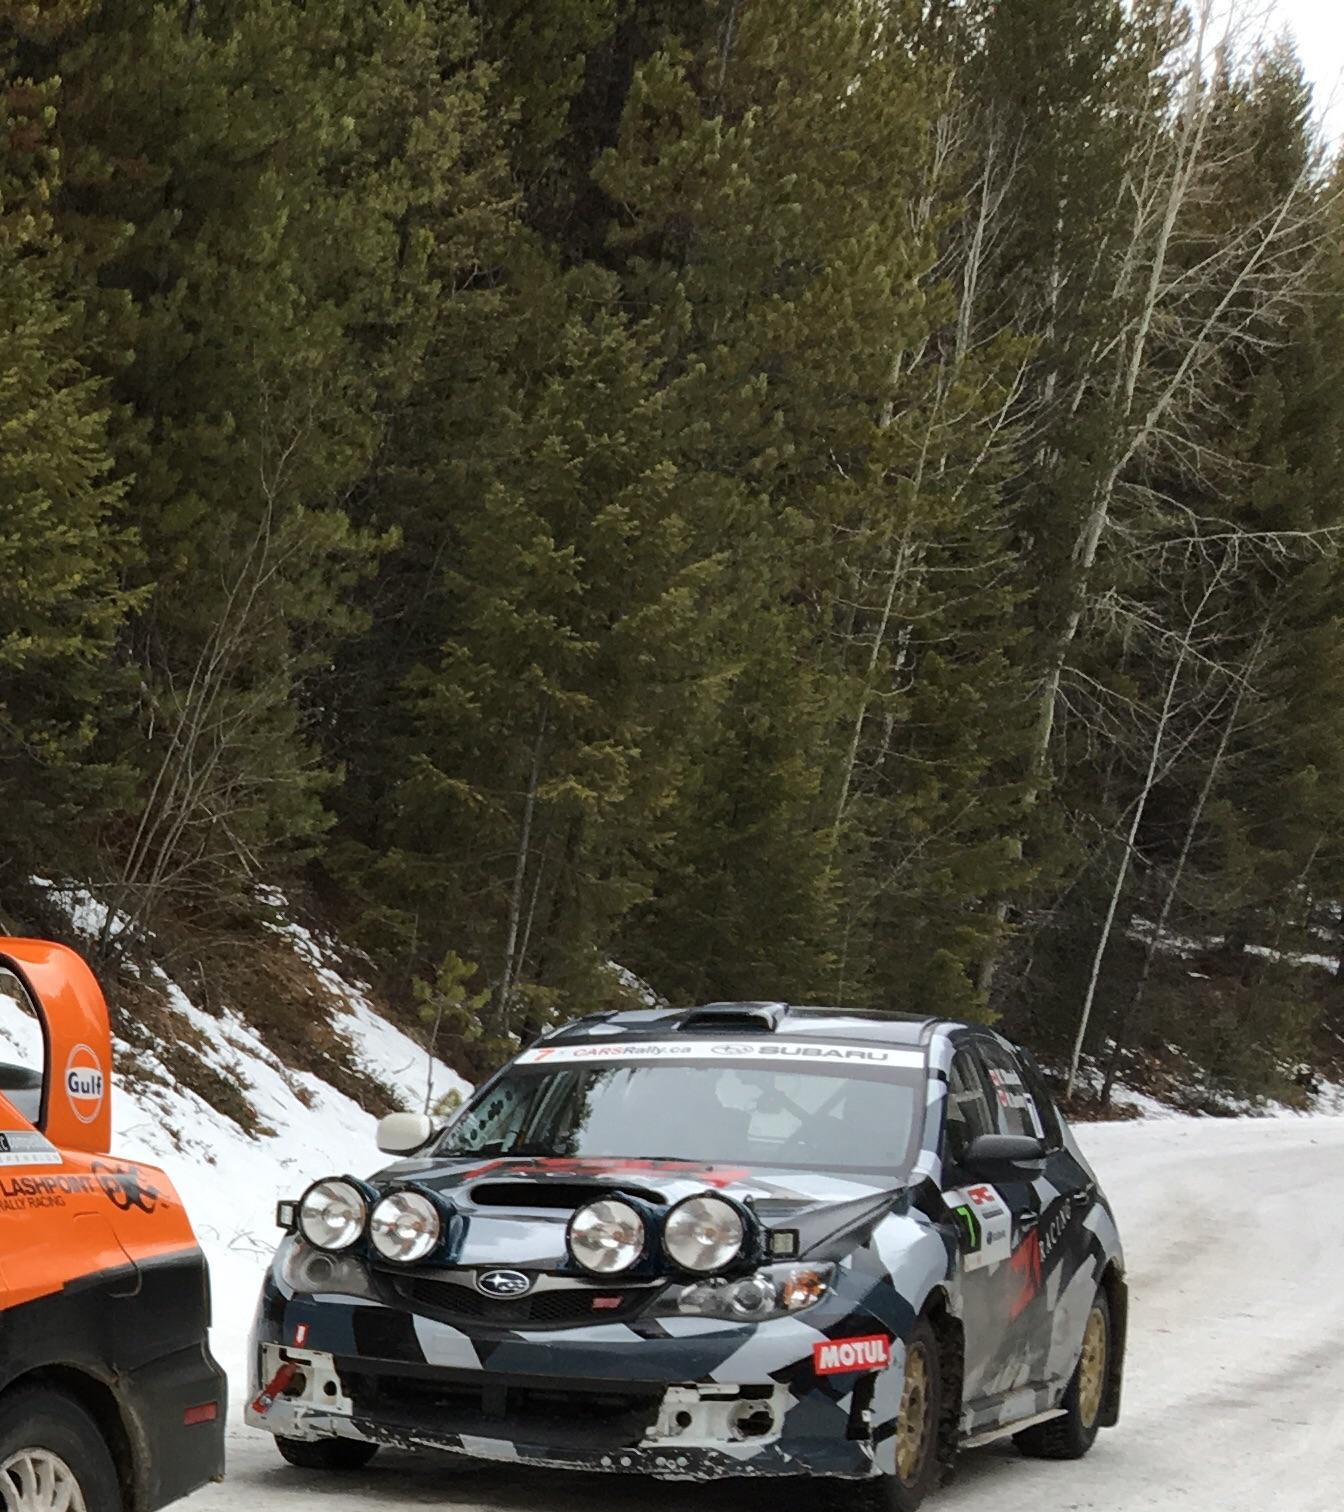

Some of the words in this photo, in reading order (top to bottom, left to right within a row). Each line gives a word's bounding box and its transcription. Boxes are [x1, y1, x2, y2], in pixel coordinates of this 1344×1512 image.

[758, 1046, 888, 1061] SUBARU
[68, 1072, 101, 1095] Gulf
[28, 1196, 66, 1208] RACING
[956, 1206, 976, 1248] 7
[819, 1340, 887, 1369] MOTUL
